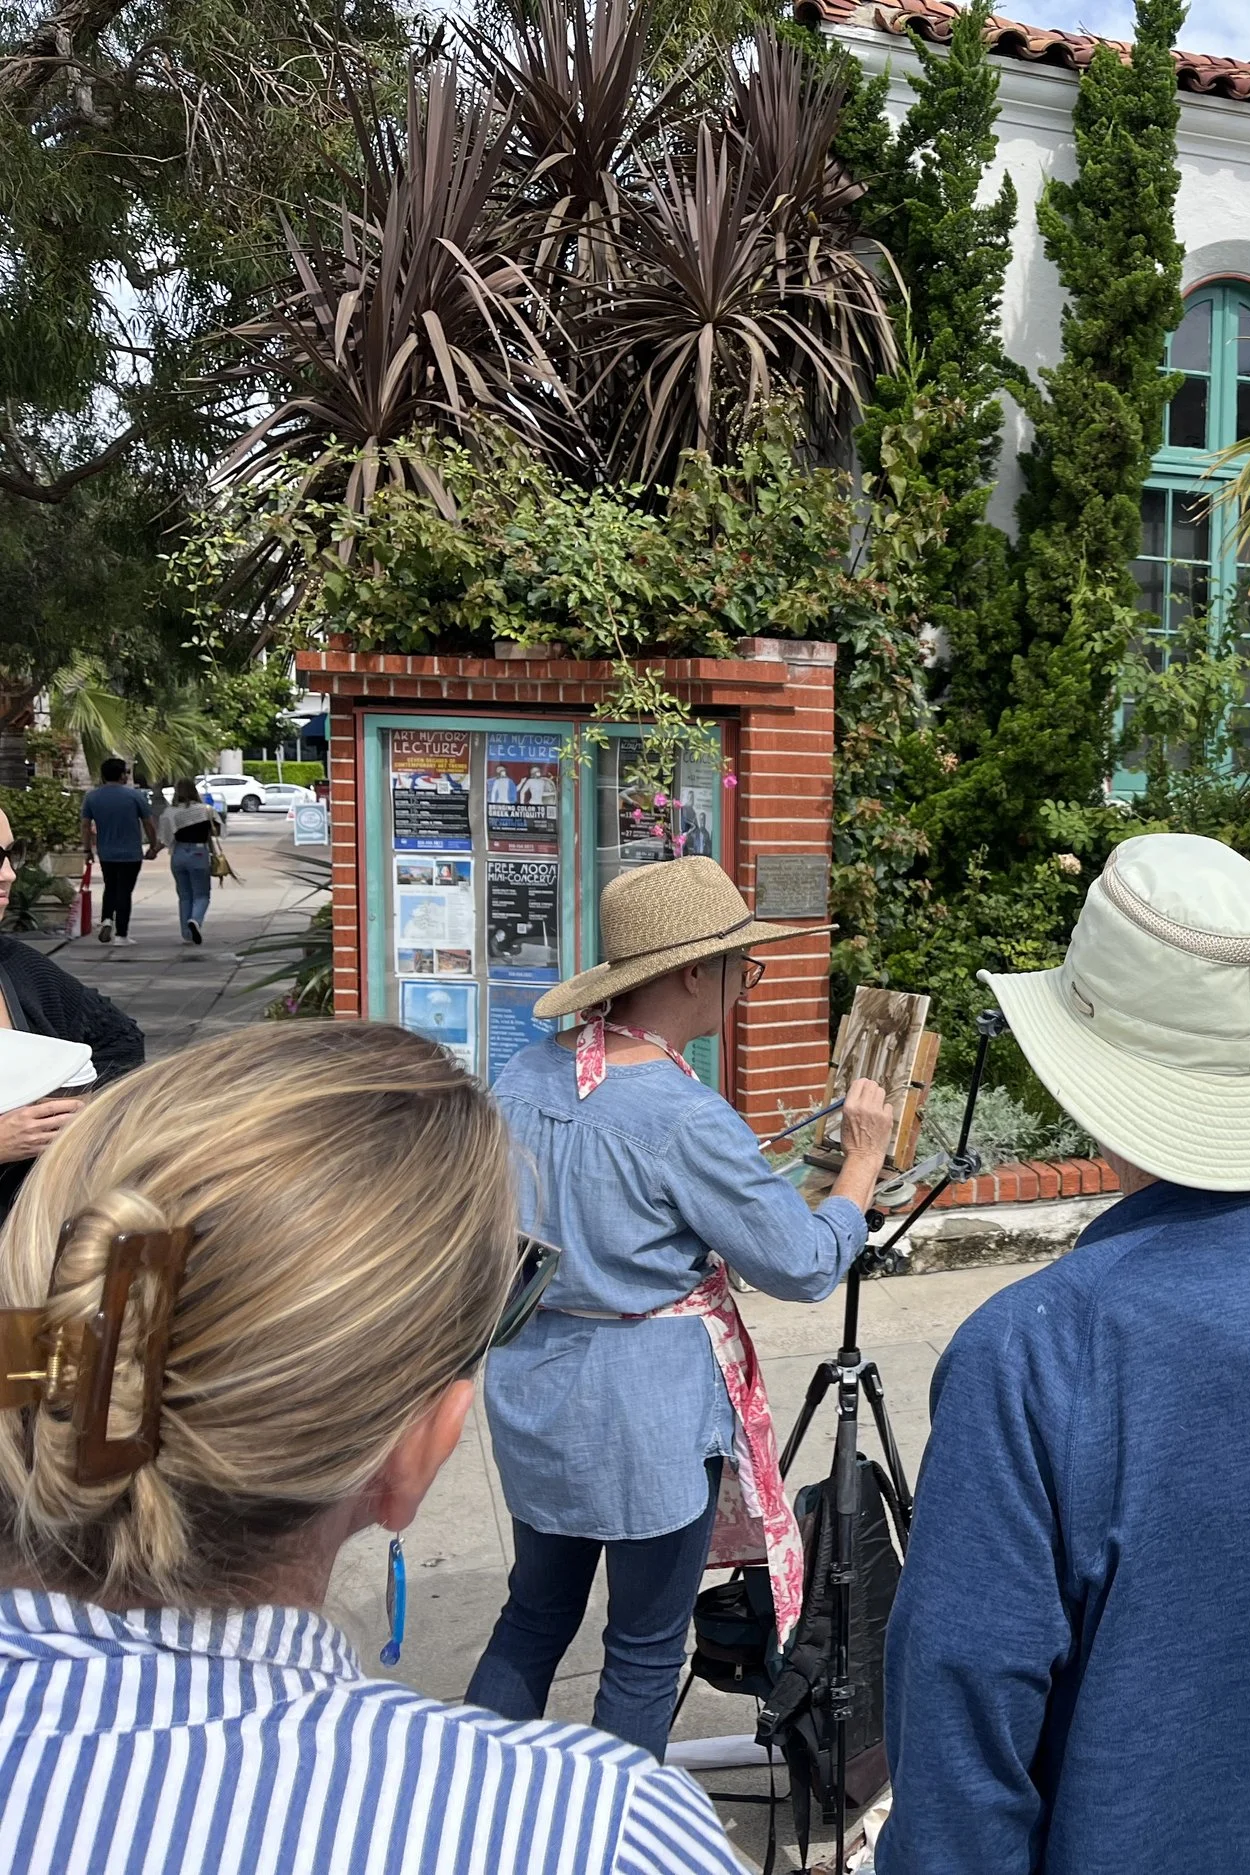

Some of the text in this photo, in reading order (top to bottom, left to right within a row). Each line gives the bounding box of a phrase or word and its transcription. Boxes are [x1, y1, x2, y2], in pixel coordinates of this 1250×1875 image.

[394, 731, 468, 743] ART HISTORY
[489, 734, 557, 745] ART HISTORY
[394, 742, 468, 756] LECTURES
[489, 745, 558, 758] LECTURE
[488, 862, 557, 875] FREE NOON
[488, 873, 557, 885] MINI-CONCERTS
